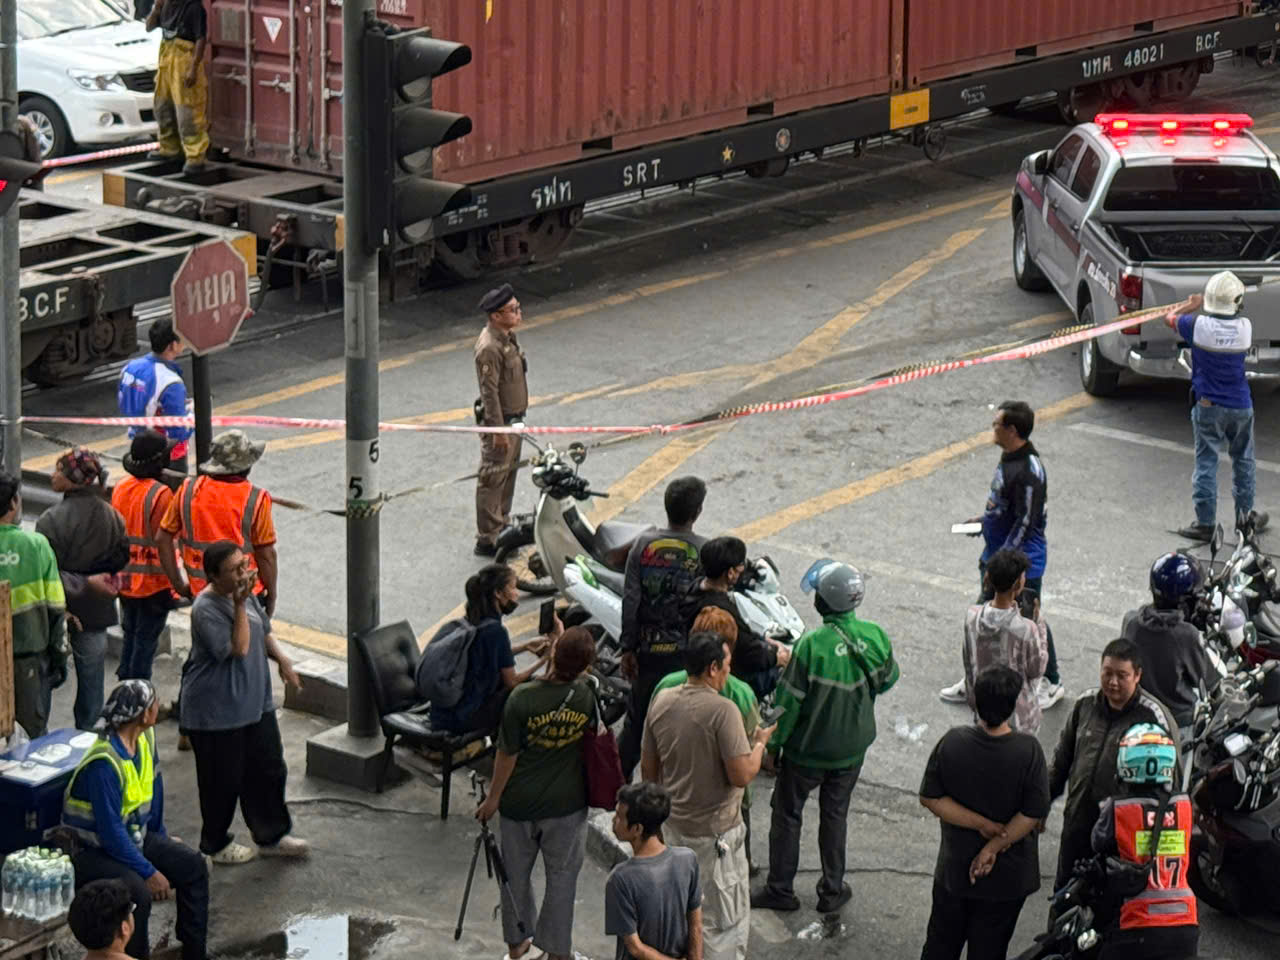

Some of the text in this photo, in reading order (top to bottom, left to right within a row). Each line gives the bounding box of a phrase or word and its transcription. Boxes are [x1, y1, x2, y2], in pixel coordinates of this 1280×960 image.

[1124, 43, 1164, 69] 48021
[623, 159, 662, 186] SRT
[185, 270, 237, 323] หยุด
[369, 441, 379, 463] 5
[349, 477, 363, 498] 5
